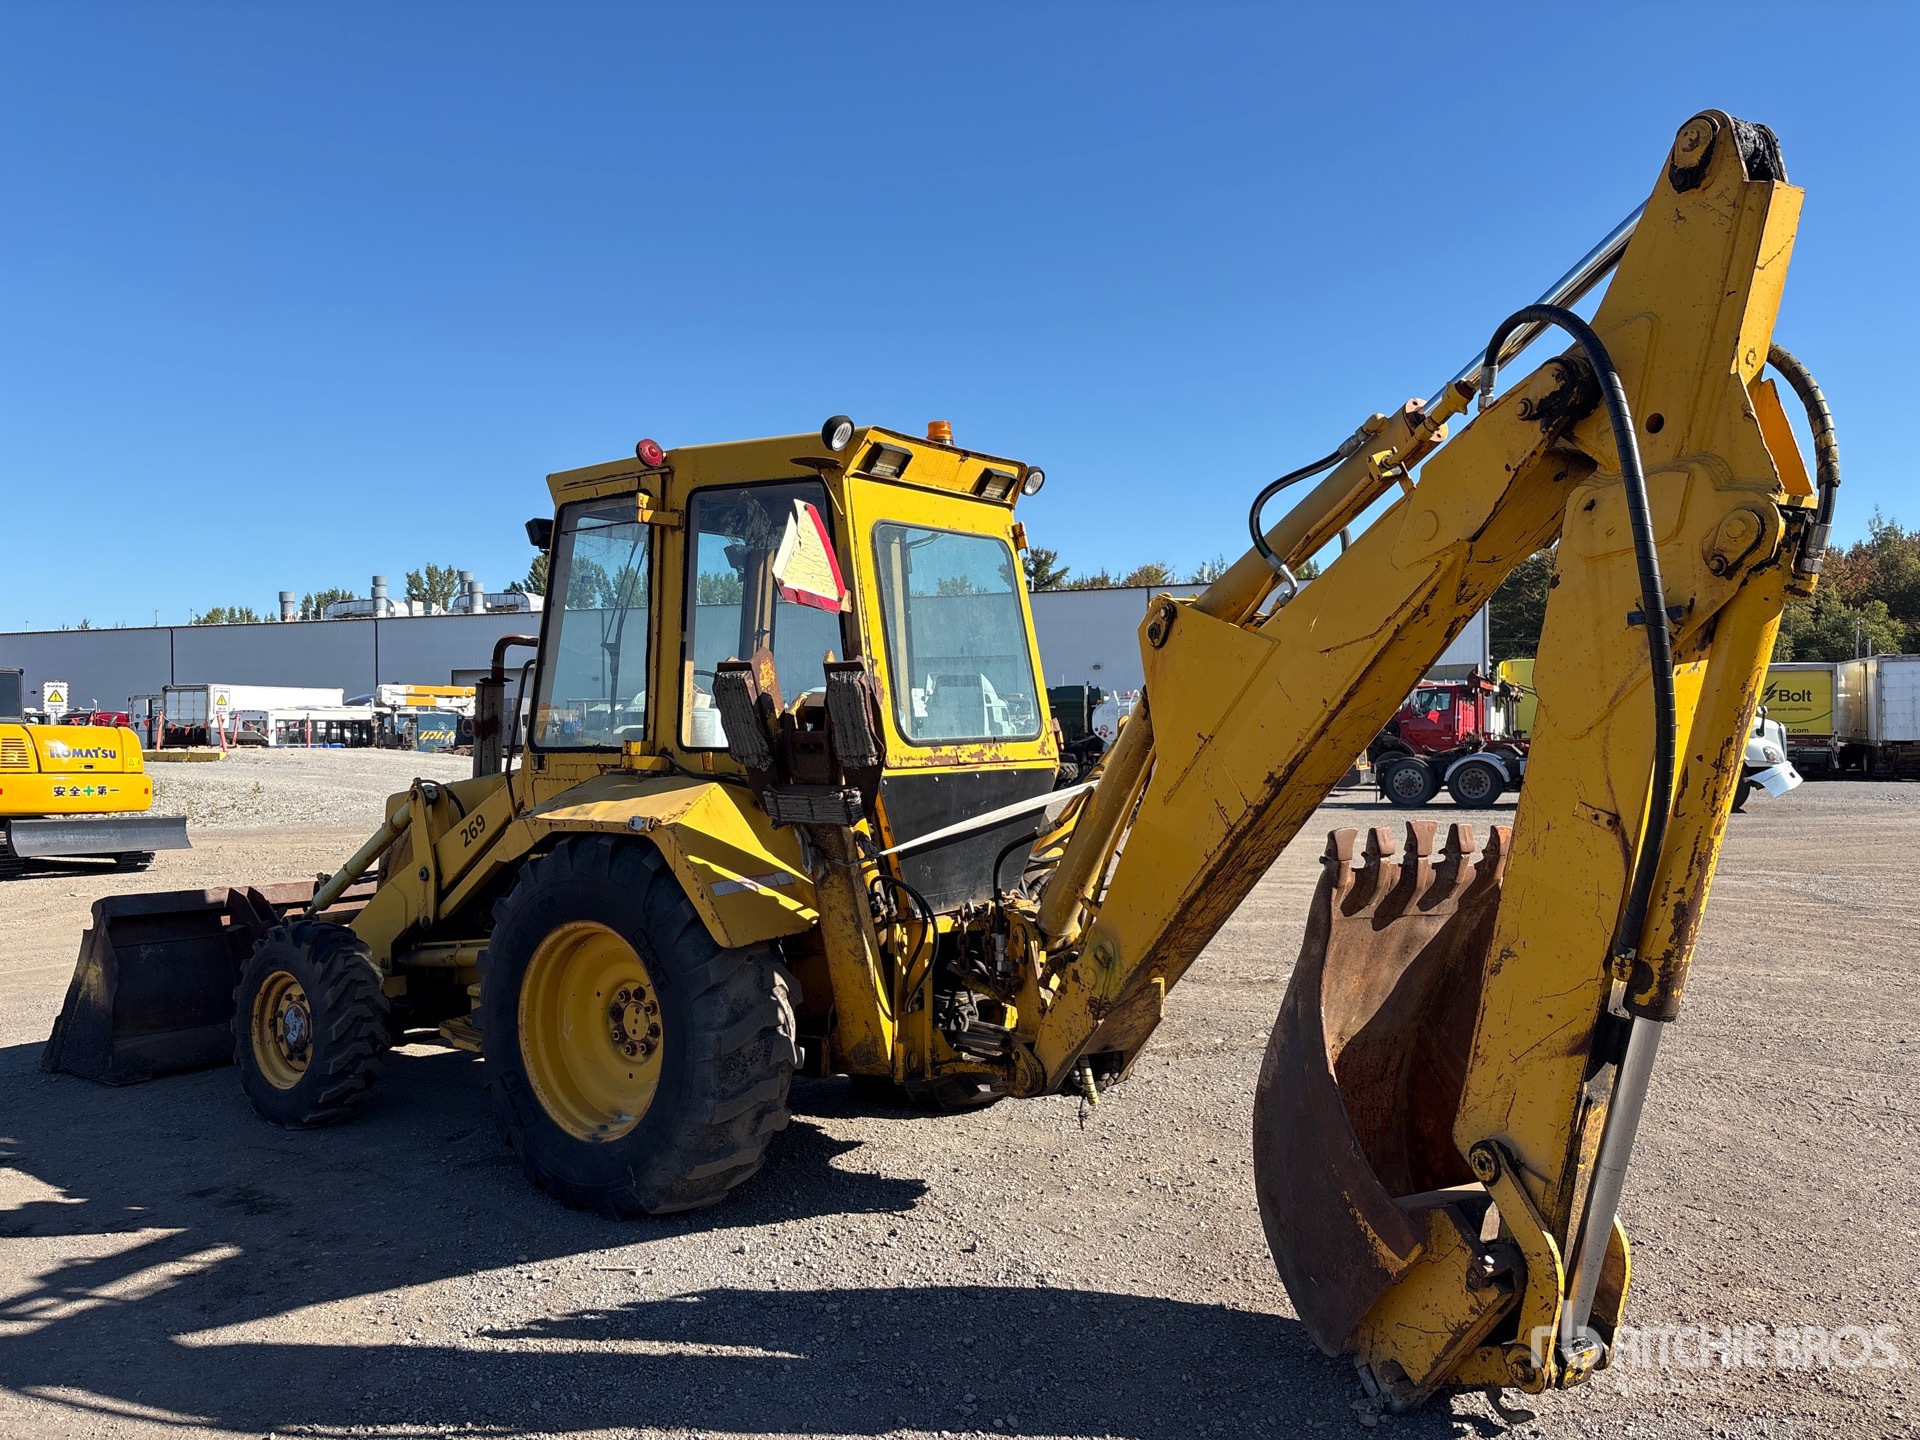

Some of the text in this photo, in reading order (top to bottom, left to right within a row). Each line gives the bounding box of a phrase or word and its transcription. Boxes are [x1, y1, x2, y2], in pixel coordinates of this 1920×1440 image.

[1778, 689, 1812, 702] Bolt
[49, 747, 117, 759] KOMATSU
[460, 814, 486, 848] 269
